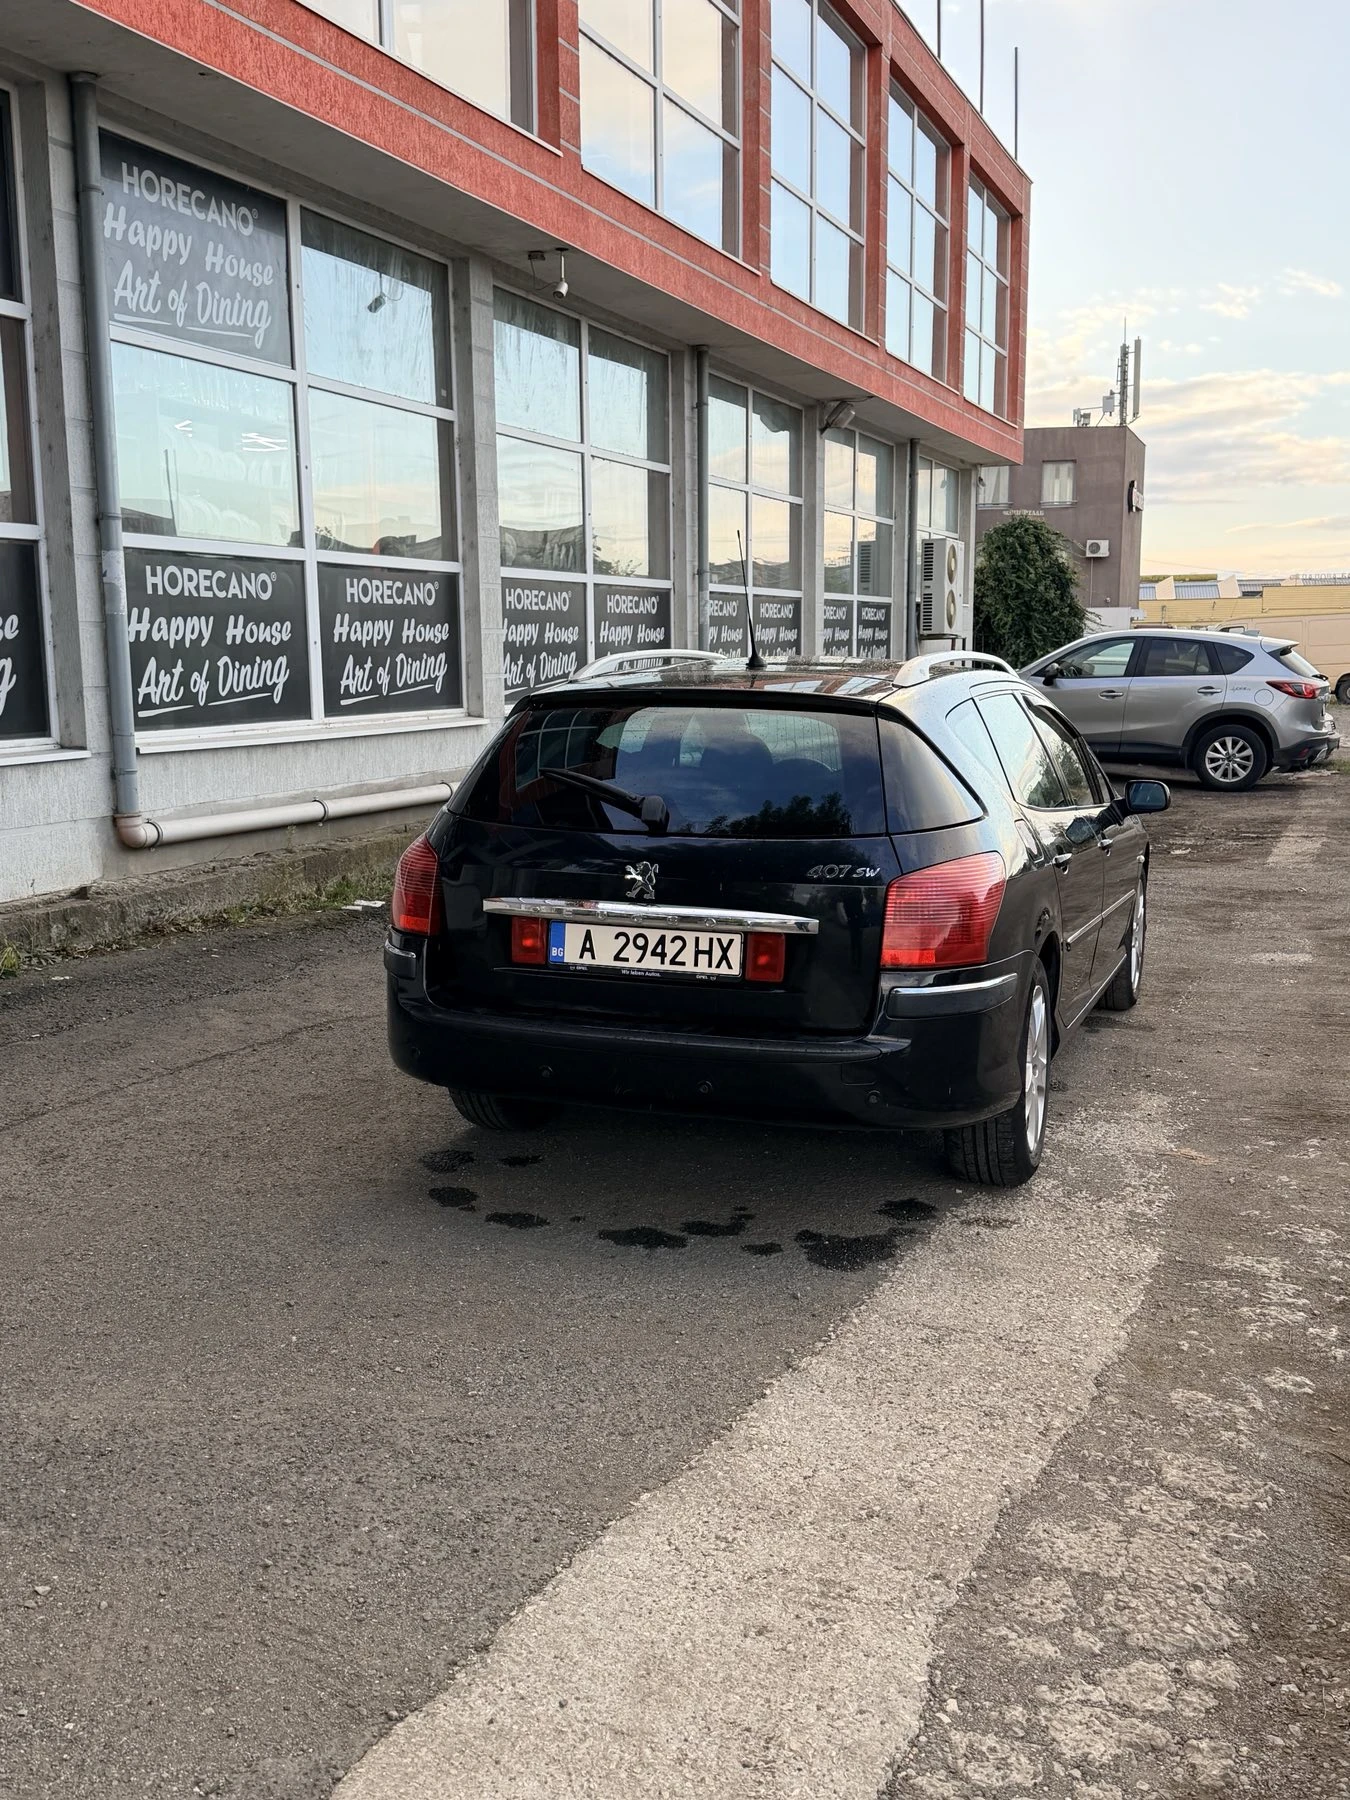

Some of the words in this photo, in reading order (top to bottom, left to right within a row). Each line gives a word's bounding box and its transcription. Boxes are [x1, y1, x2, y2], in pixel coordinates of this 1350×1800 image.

[103, 203, 193, 266] Happy
[205, 241, 274, 287] House
[113, 260, 162, 314] Art
[168, 280, 188, 328] of
[196, 281, 272, 349] Dining
[709, 600, 738, 617] RECANO
[128, 607, 215, 648] Happy
[226, 614, 292, 646] House
[333, 613, 394, 648] Happy
[401, 618, 450, 645] House
[544, 622, 579, 645] House
[600, 621, 634, 646] Happy
[637, 624, 665, 644] House
[137, 656, 184, 706] Art
[190, 665, 210, 706] of
[217, 654, 290, 704] Dining
[340, 654, 374, 695] Art
[376, 662, 391, 697] of
[396, 651, 448, 694] Dining
[502, 651, 524, 686] Art
[526, 655, 536, 687] of
[540, 651, 577, 681] Dining
[807, 863, 852, 878] 407
[551, 947, 564, 957] BG
[578, 929, 596, 961] A
